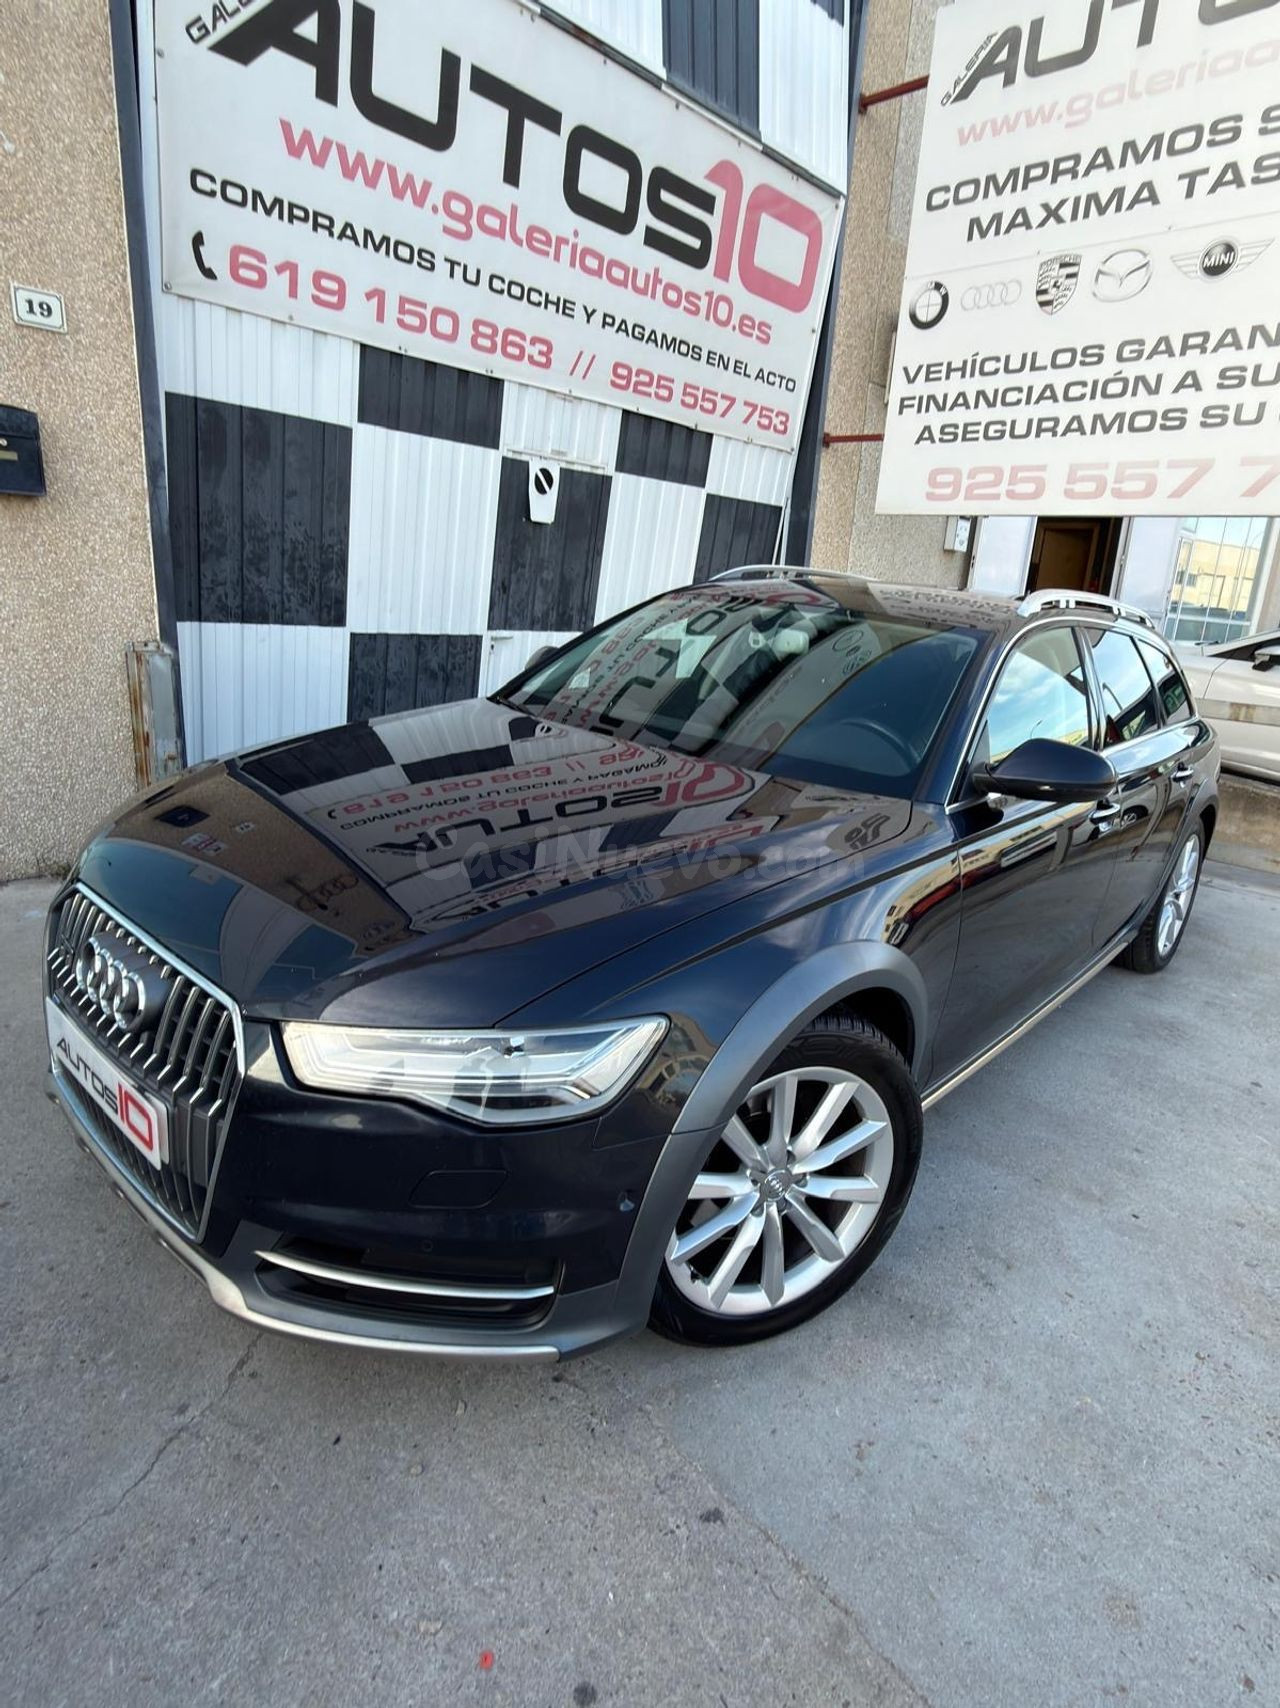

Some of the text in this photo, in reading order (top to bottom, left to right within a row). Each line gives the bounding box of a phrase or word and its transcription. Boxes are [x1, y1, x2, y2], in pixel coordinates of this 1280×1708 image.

[207, 0, 823, 313] AUTOS10
[925, 114, 1243, 212] COMPRAMOS
[966, 152, 1280, 242] MAXIMA TAS
[279, 117, 772, 345] www.galeriaautos10.es
[1202, 251, 1235, 269] MINI
[25, 298, 53, 318] 19
[190, 168, 797, 393] COMPRAMOS TU COCHE Y PAGAMOS EN EL ACTO
[228, 244, 347, 311] 619
[364, 287, 460, 344] 150
[470, 318, 553, 369] 863
[610, 361, 675, 403] 925
[680, 383, 736, 419] 557
[742, 400, 790, 435] 753
[902, 322, 1280, 384] VEHÍCULOS GARAN
[898, 361, 1280, 416] FINANCIACIÓN A SU
[914, 401, 1267, 446] ASEGURAMOS SU
[925, 464, 1048, 502] 925
[1063, 457, 1216, 501] 557
[57, 1038, 154, 1152] AUTOS10
